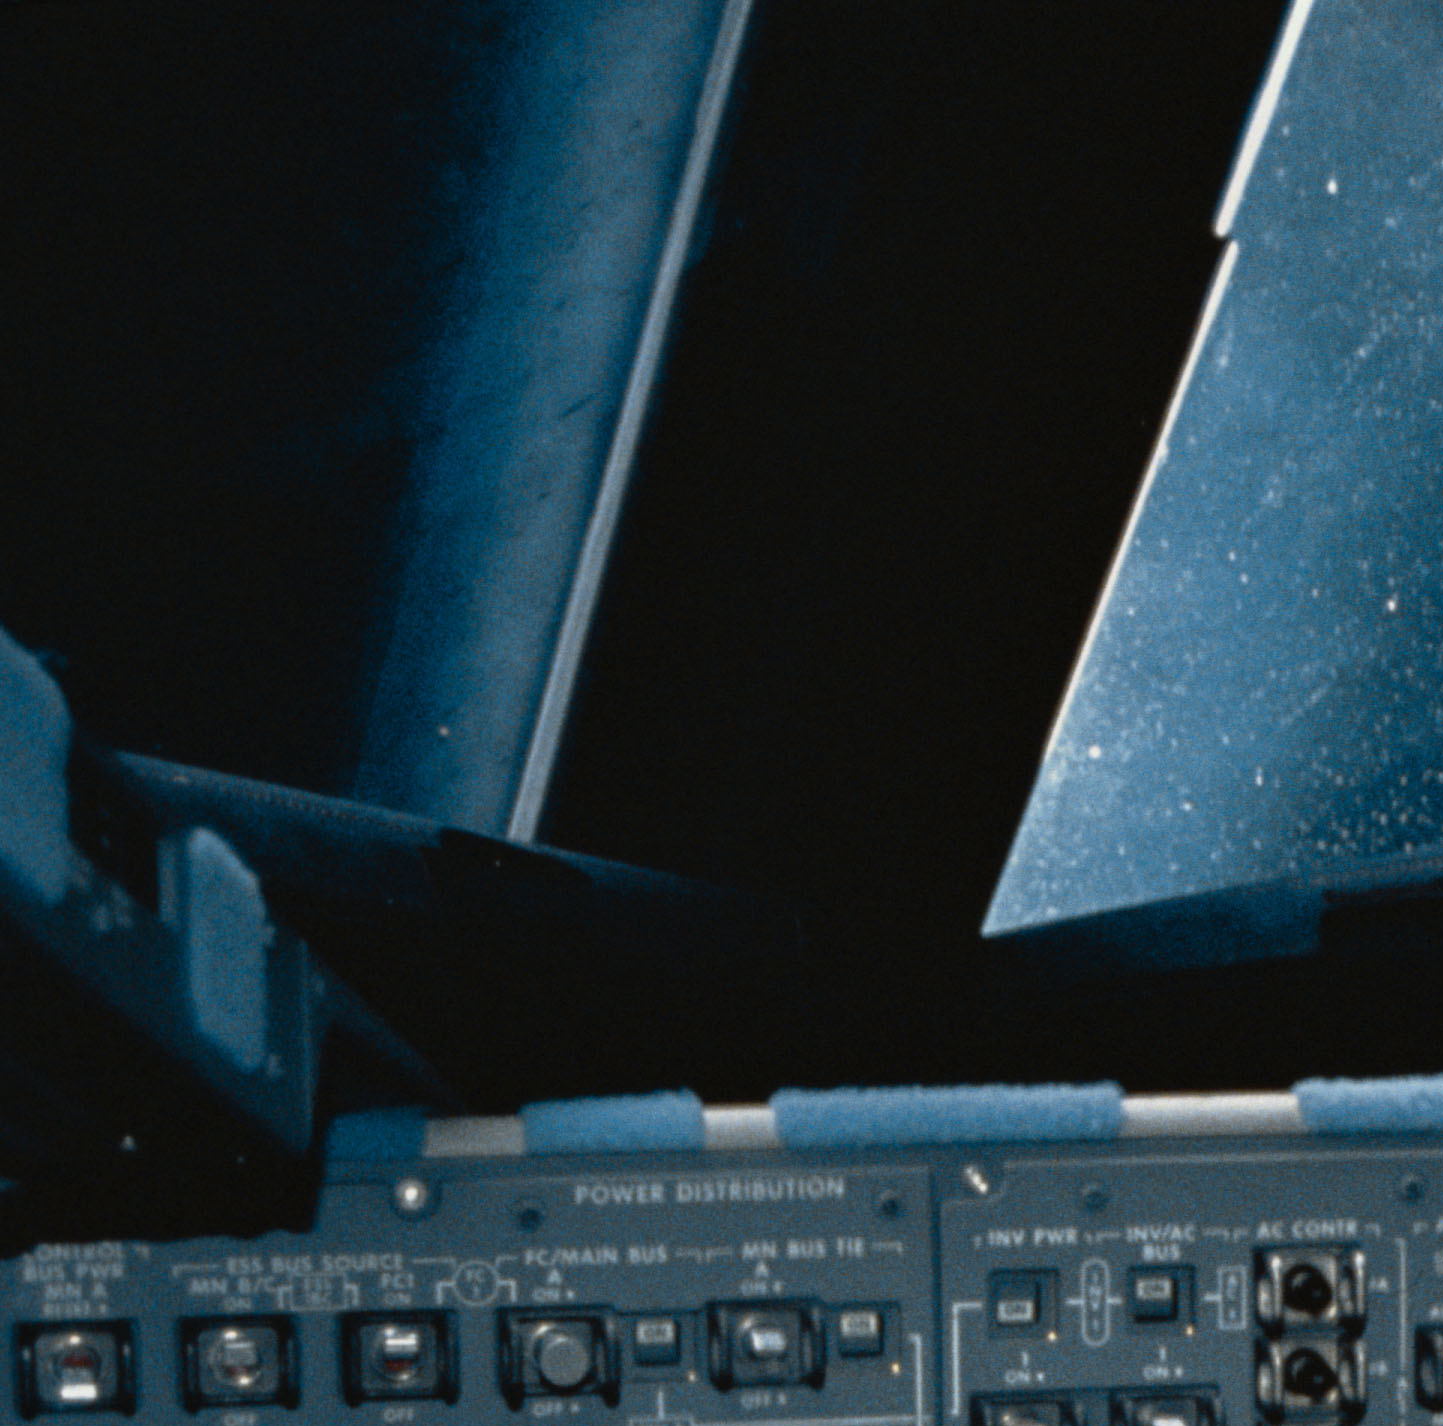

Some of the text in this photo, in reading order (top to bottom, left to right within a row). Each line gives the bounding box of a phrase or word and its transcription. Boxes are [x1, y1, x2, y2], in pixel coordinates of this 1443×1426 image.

[575, 1178, 844, 1204] POWER DISTRIBUTION
[988, 1228, 1076, 1246] INV PWR
[1258, 1223, 1281, 1238] AC
[628, 1245, 667, 1263] BUS
[788, 1241, 825, 1257] BUS
[837, 1238, 863, 1256] TIE
